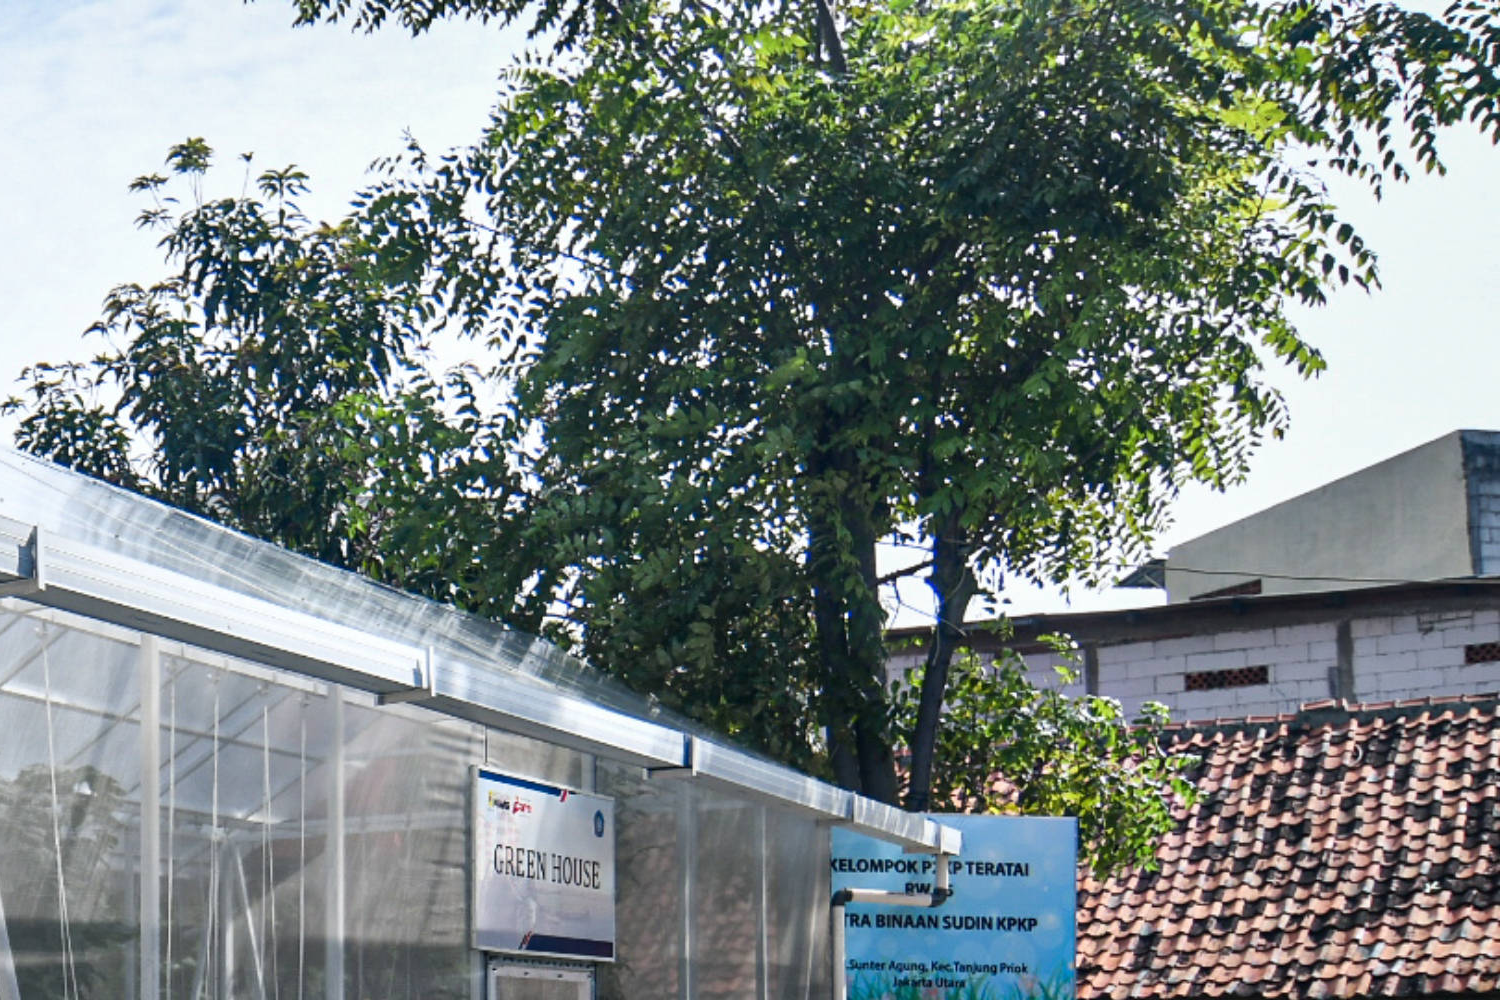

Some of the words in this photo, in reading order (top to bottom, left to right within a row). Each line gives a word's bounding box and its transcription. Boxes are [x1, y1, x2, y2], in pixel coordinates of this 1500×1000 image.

[494, 844, 547, 880] GREEN
[551, 853, 600, 889] HOUSE
[965, 861, 1029, 876] TERATAI
[875, 914, 938, 929] BINAAN
[942, 915, 993, 930] SUDIN
[996, 916, 1038, 932] KPKP
[999, 962, 1028, 974] Priok
[892, 976, 932, 988] Jakarta
[935, 978, 966, 988] Utara
